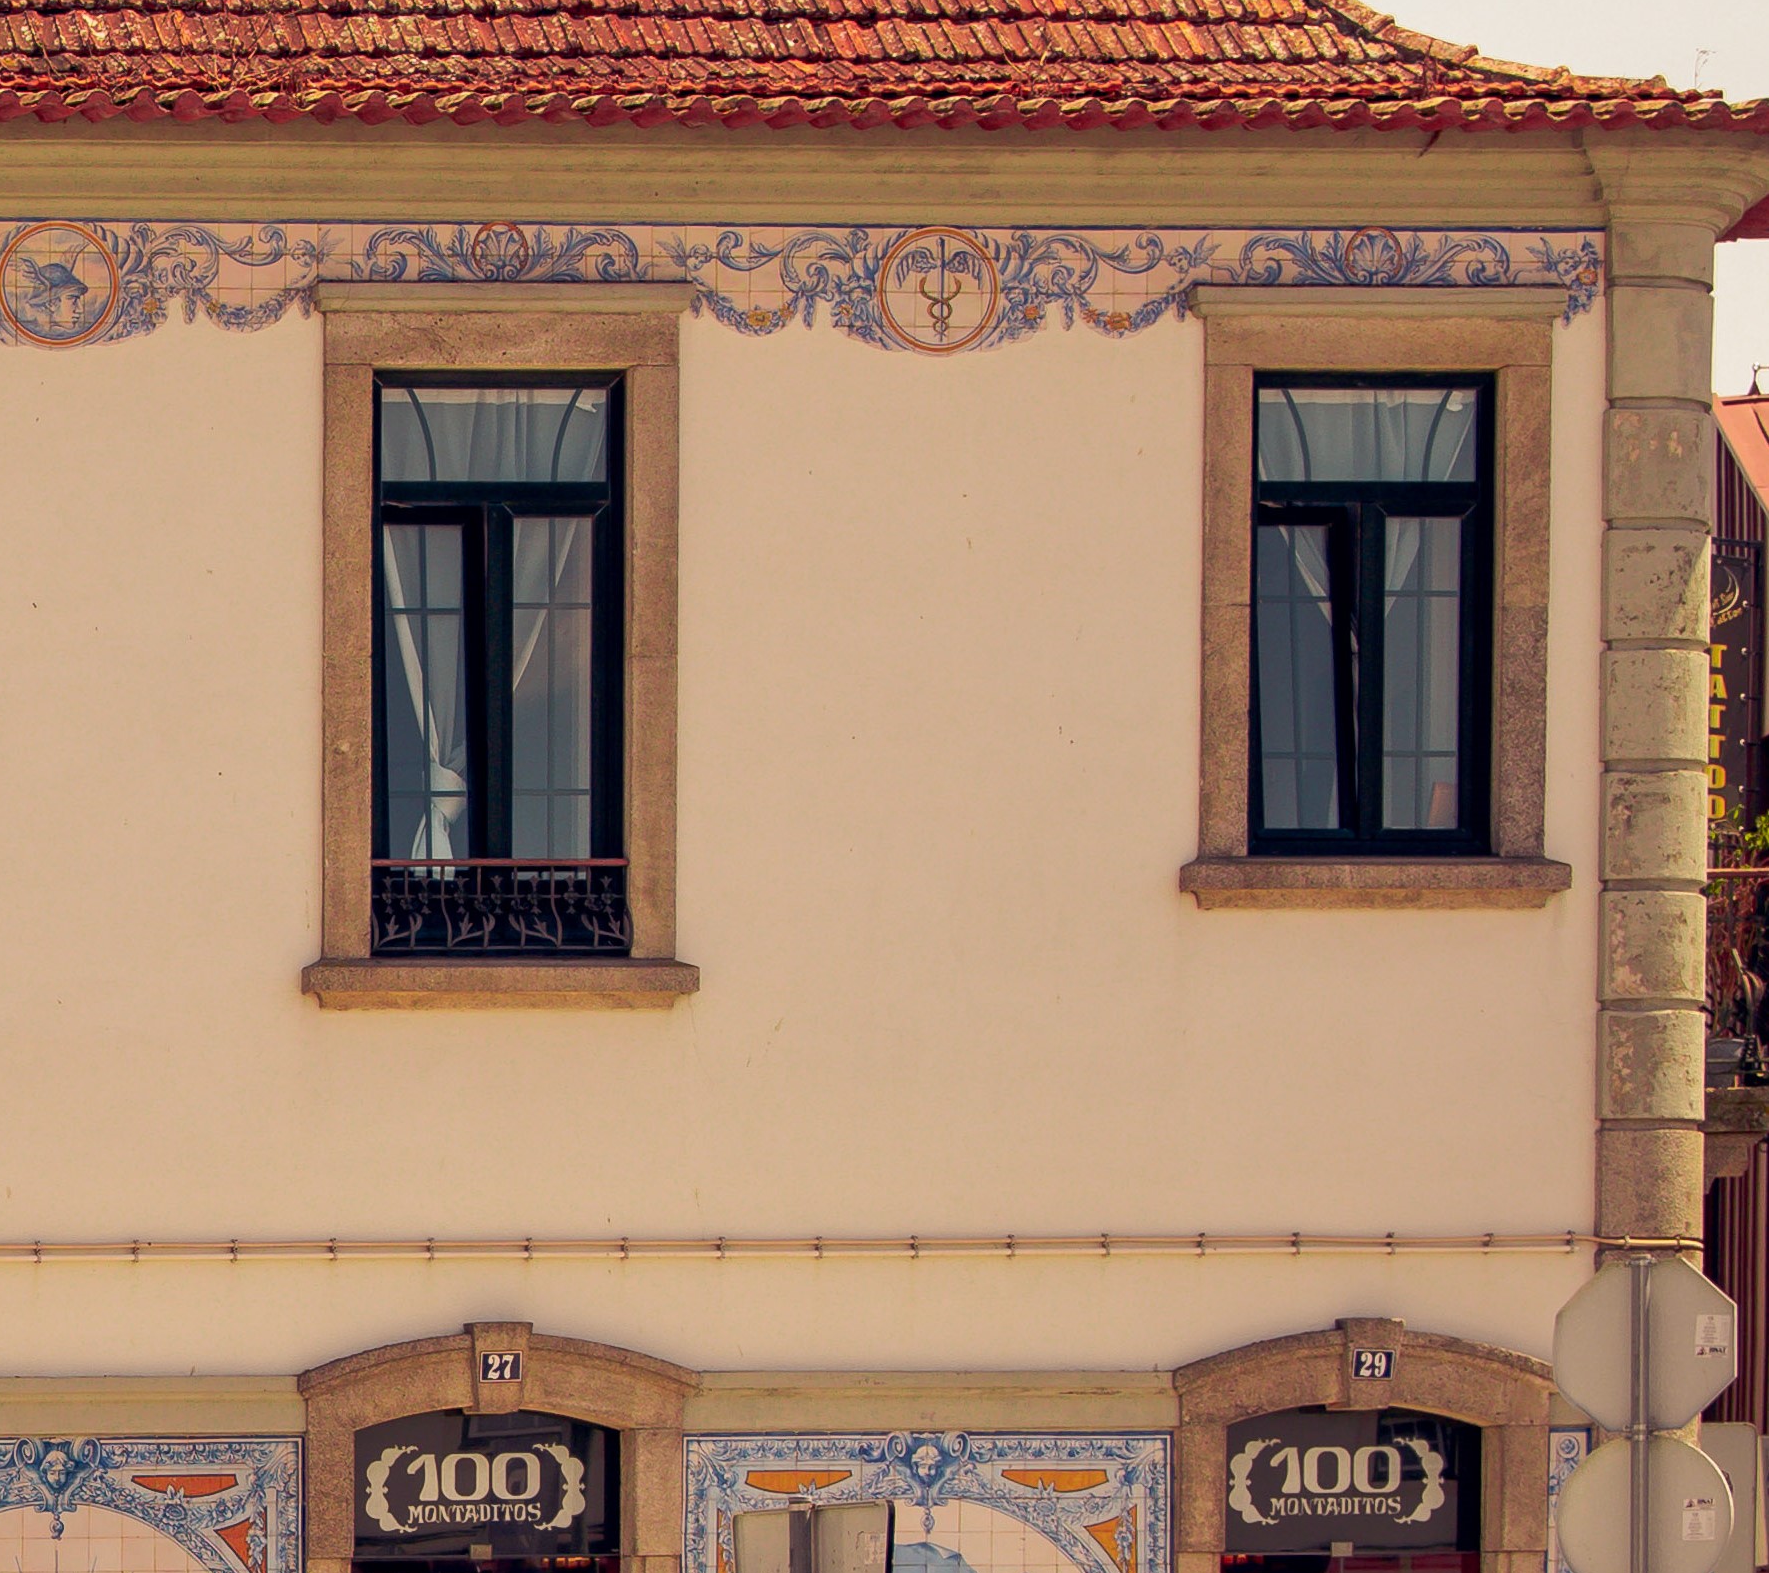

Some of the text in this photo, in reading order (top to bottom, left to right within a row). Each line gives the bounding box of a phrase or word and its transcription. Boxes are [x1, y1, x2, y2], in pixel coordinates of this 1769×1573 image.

[1708, 644, 1727, 819] TATTOO
[487, 1355, 514, 1380] 27
[1359, 1352, 1386, 1378] 29
[406, 1452, 541, 1502] 100
[1269, 1446, 1402, 1495] 100
[407, 1503, 542, 1525] MONTADITOS
[1270, 1495, 1402, 1517] MONTADITOS
